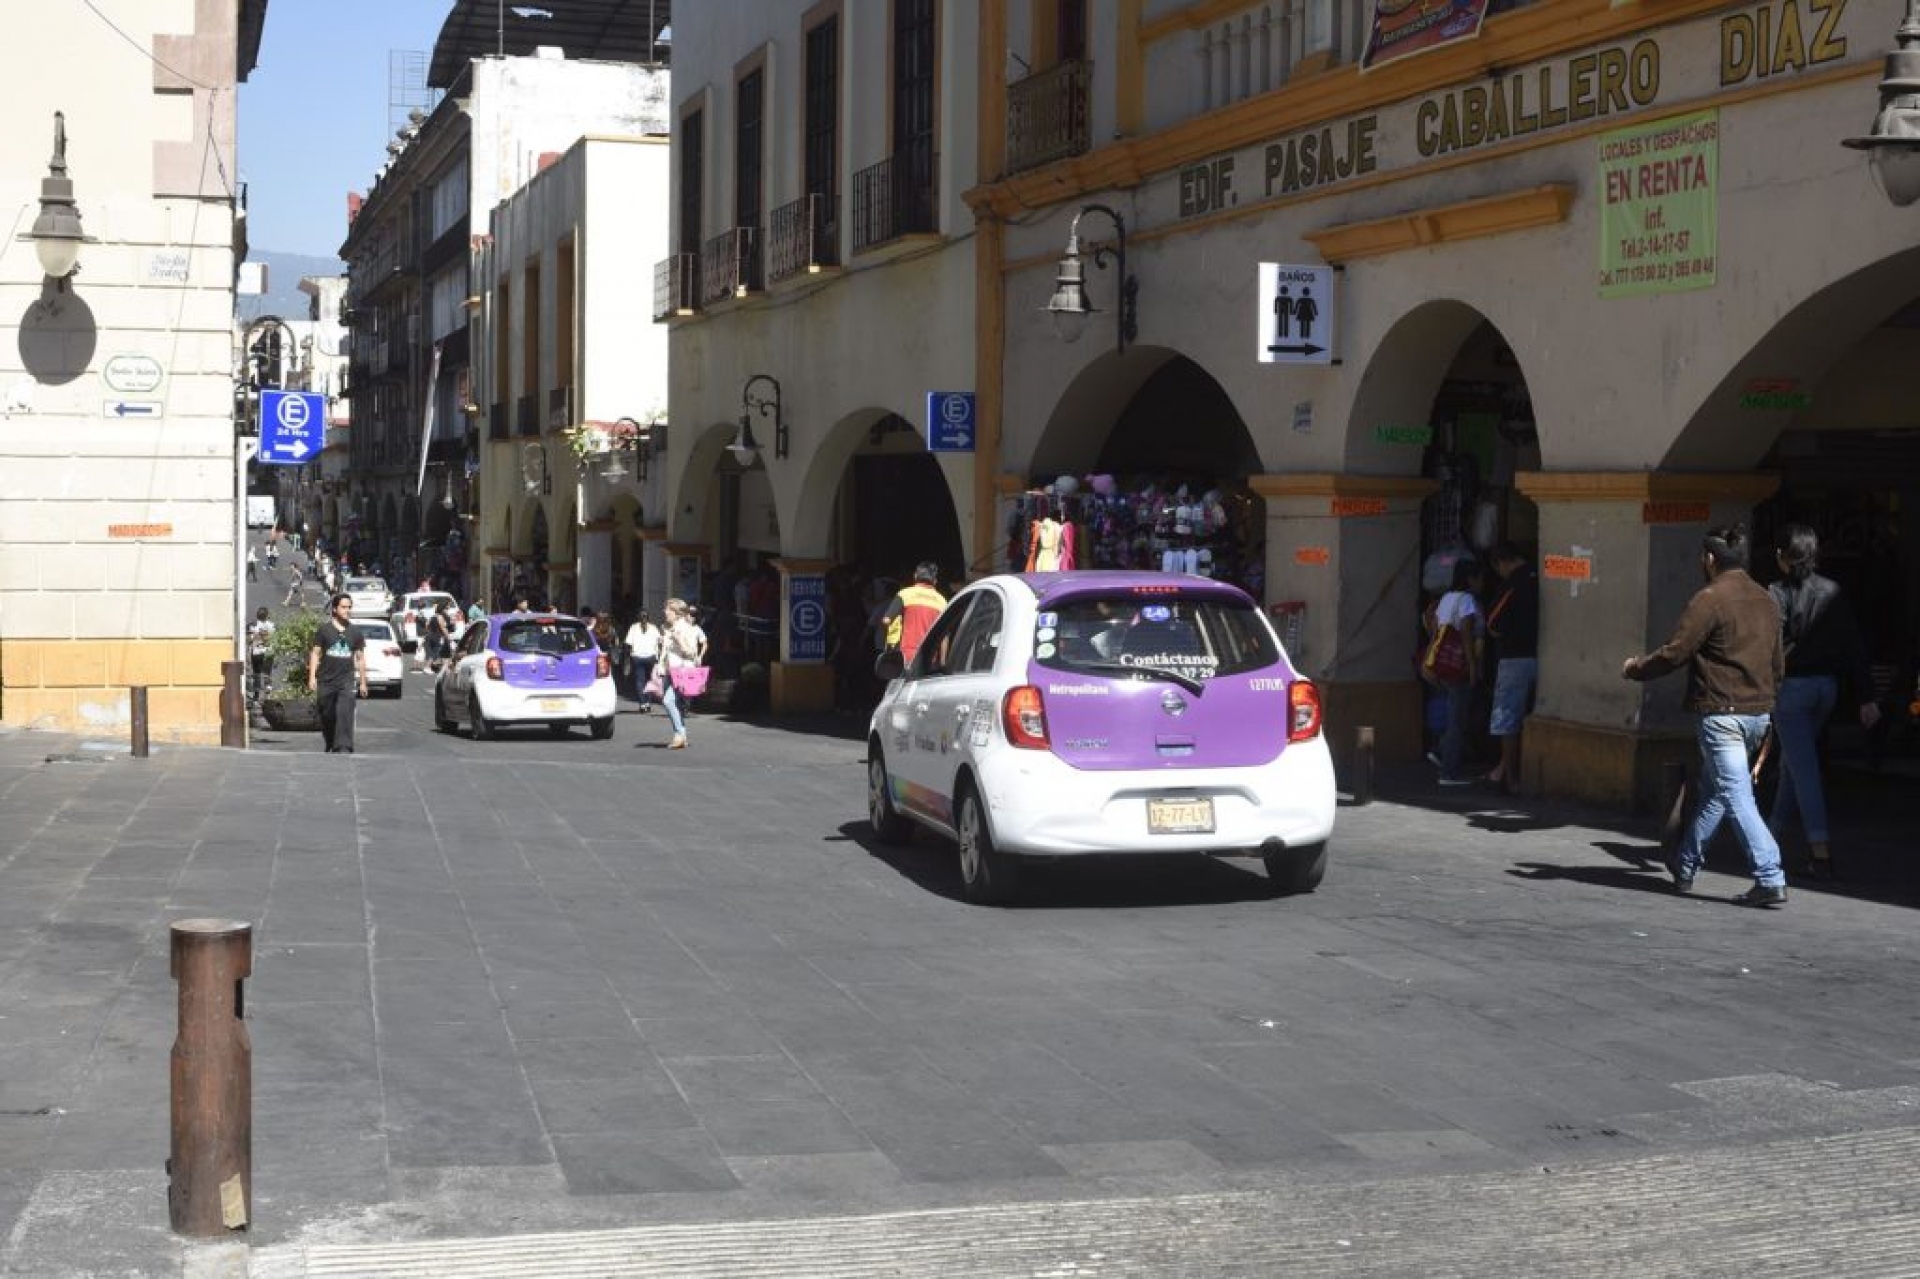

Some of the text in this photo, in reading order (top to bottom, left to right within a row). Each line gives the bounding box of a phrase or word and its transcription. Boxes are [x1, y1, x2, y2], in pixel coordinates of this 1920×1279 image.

[1179, 0, 1847, 219] EDIF. PASAJE CABALLERO DIAZ
[1600, 121, 1717, 162] LOCALES Y DESPACHOS
[1606, 153, 1709, 205] EN RENTA
[1279, 270, 1315, 282] BAÑOS
